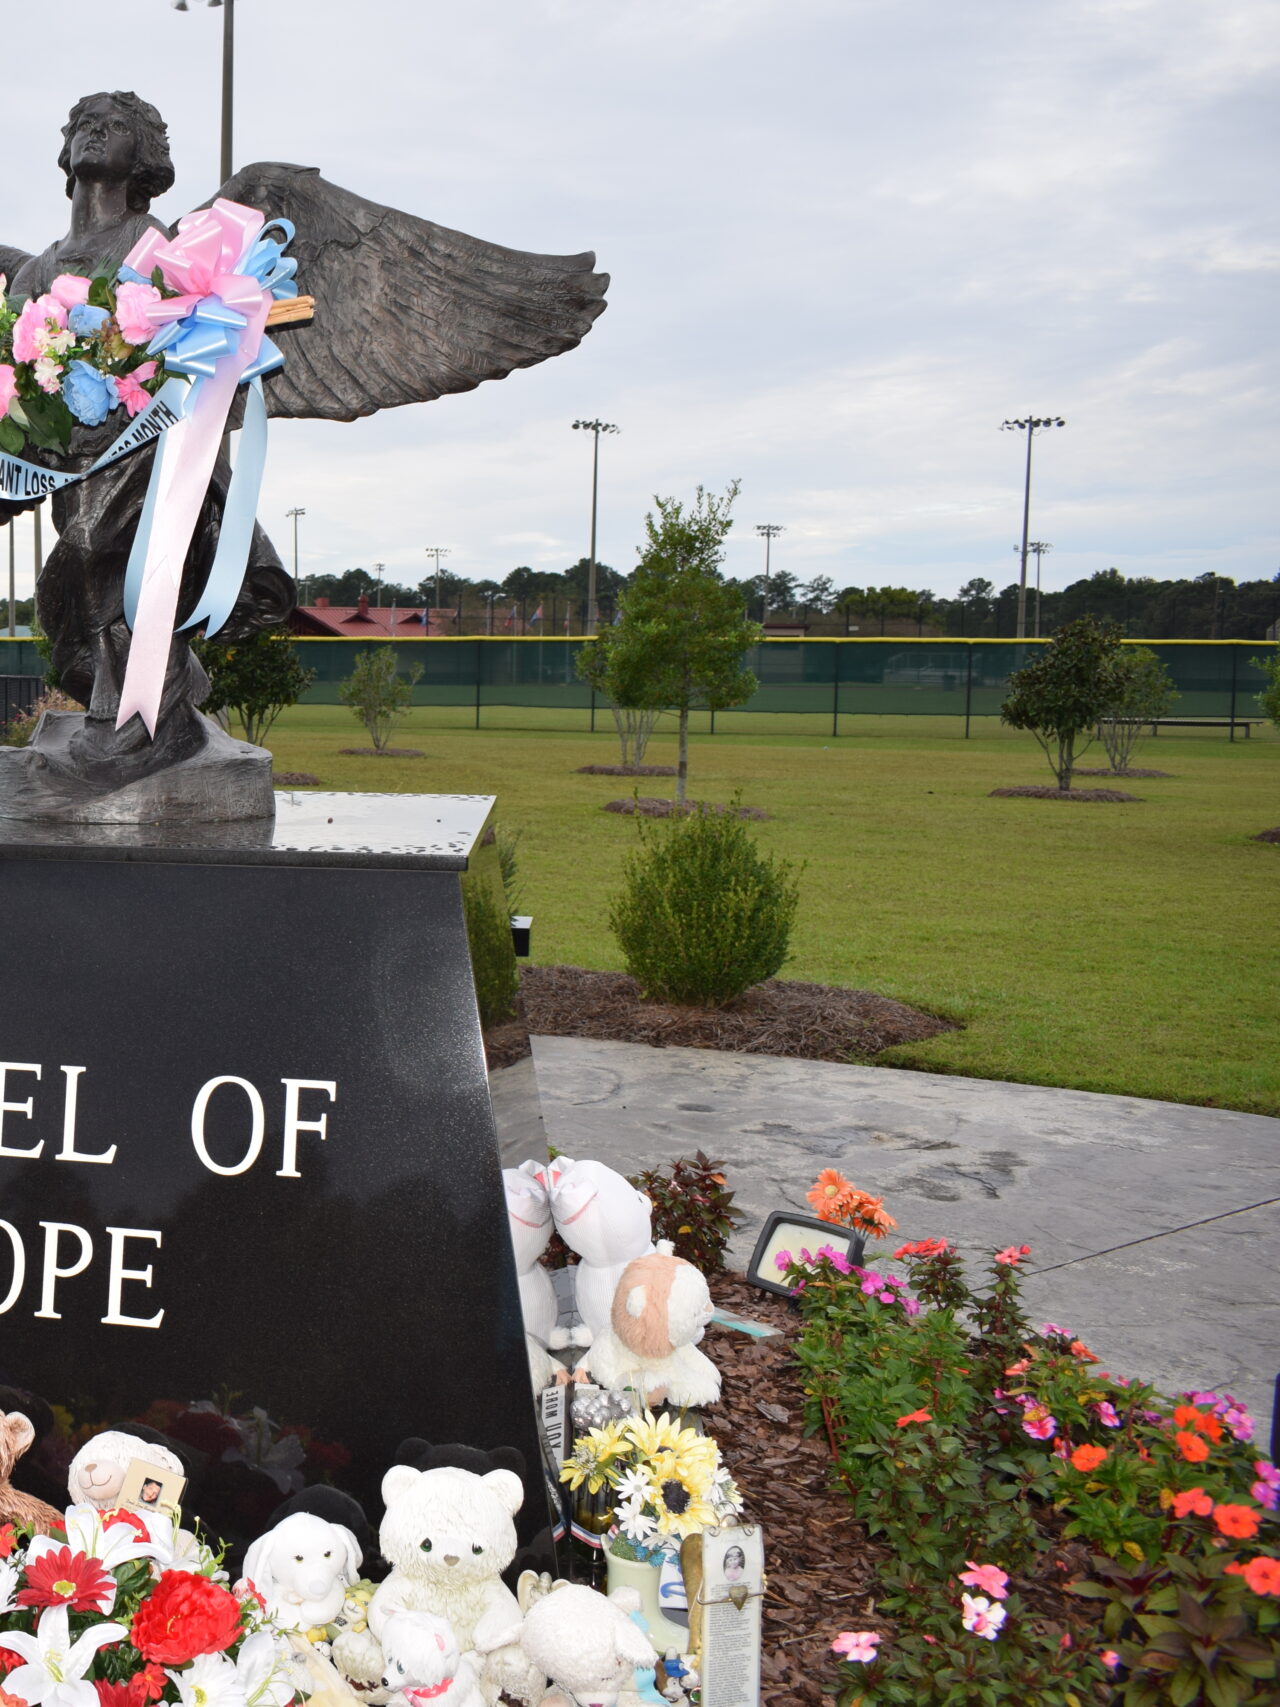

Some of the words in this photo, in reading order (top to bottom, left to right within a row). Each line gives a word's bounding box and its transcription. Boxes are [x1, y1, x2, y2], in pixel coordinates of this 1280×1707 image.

[24, 467, 56, 496] LOSS
[132, 400, 179, 442] MONTH
[191, 1075, 337, 1178] OF
